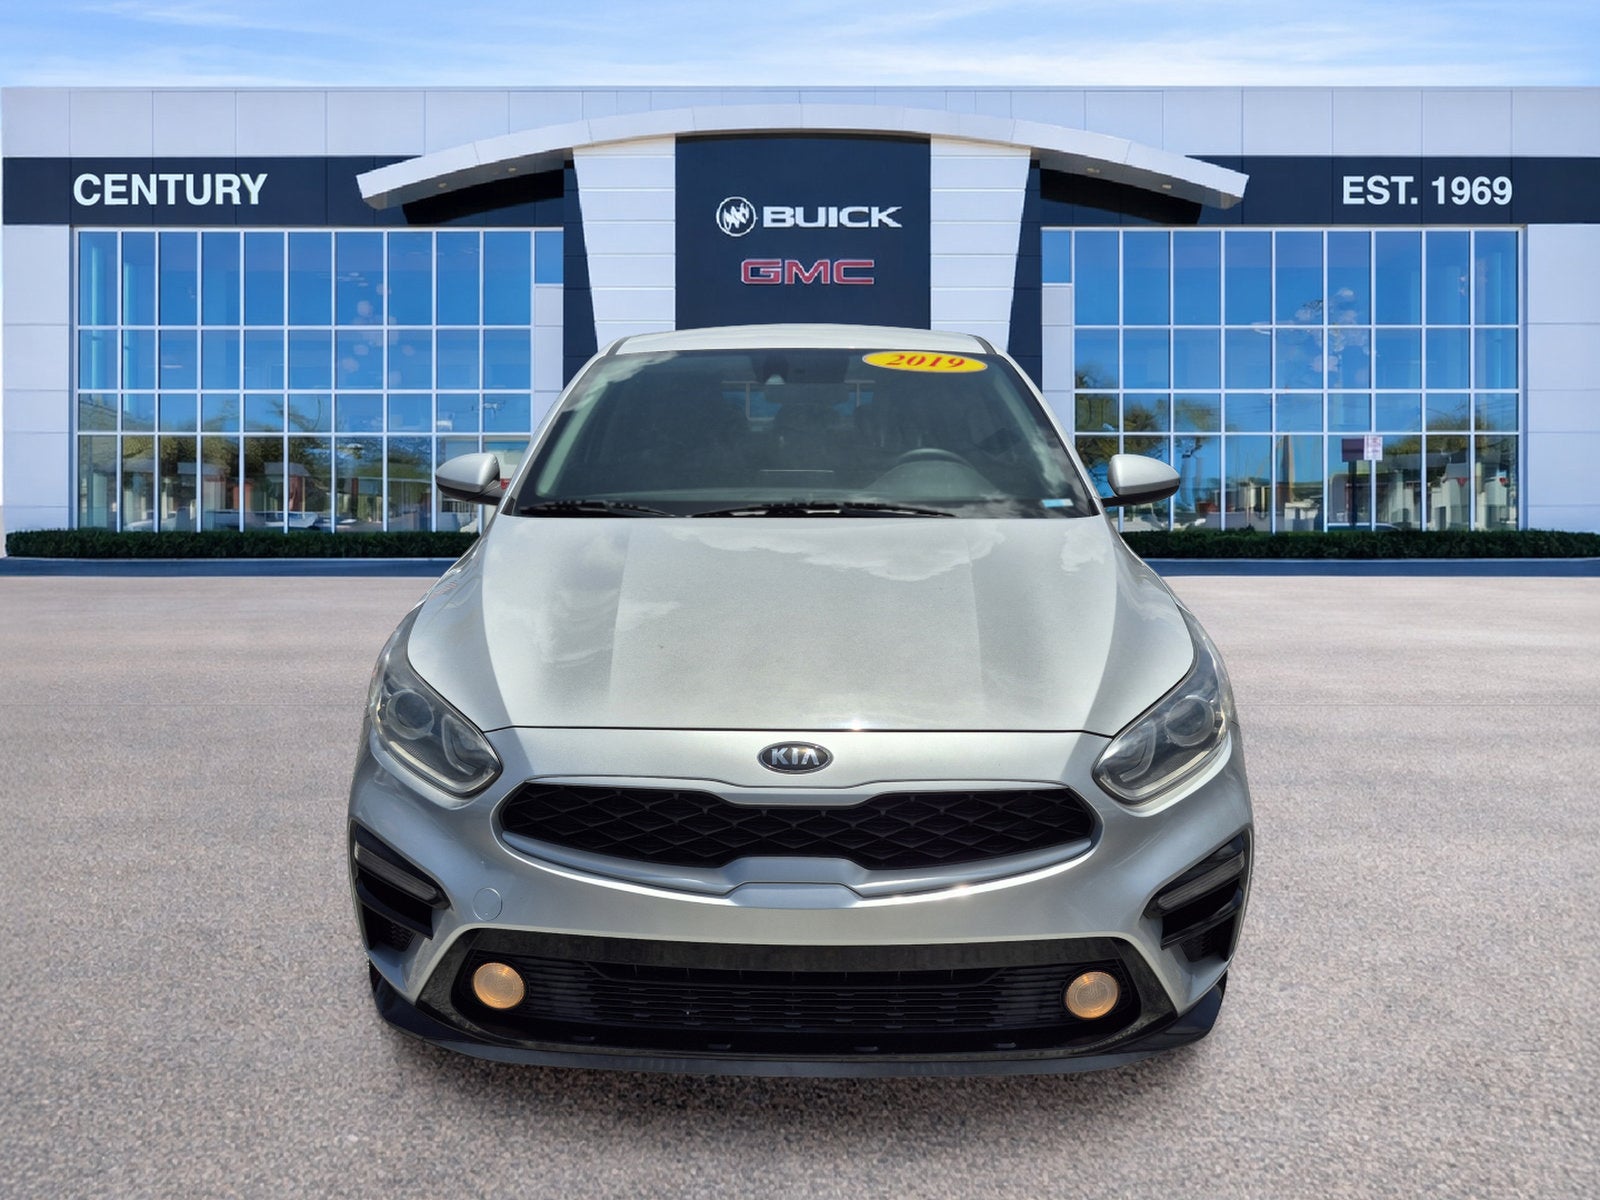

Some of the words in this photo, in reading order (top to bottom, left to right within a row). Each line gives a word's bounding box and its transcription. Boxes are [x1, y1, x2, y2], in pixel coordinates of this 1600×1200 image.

[73, 173, 268, 206] CENTURY
[1342, 175, 1418, 205] EST.
[1431, 176, 1513, 205] 1969
[763, 206, 902, 228] BUICK
[741, 259, 875, 285] GMC
[885, 354, 965, 368] 2019
[771, 747, 820, 766] KIA
